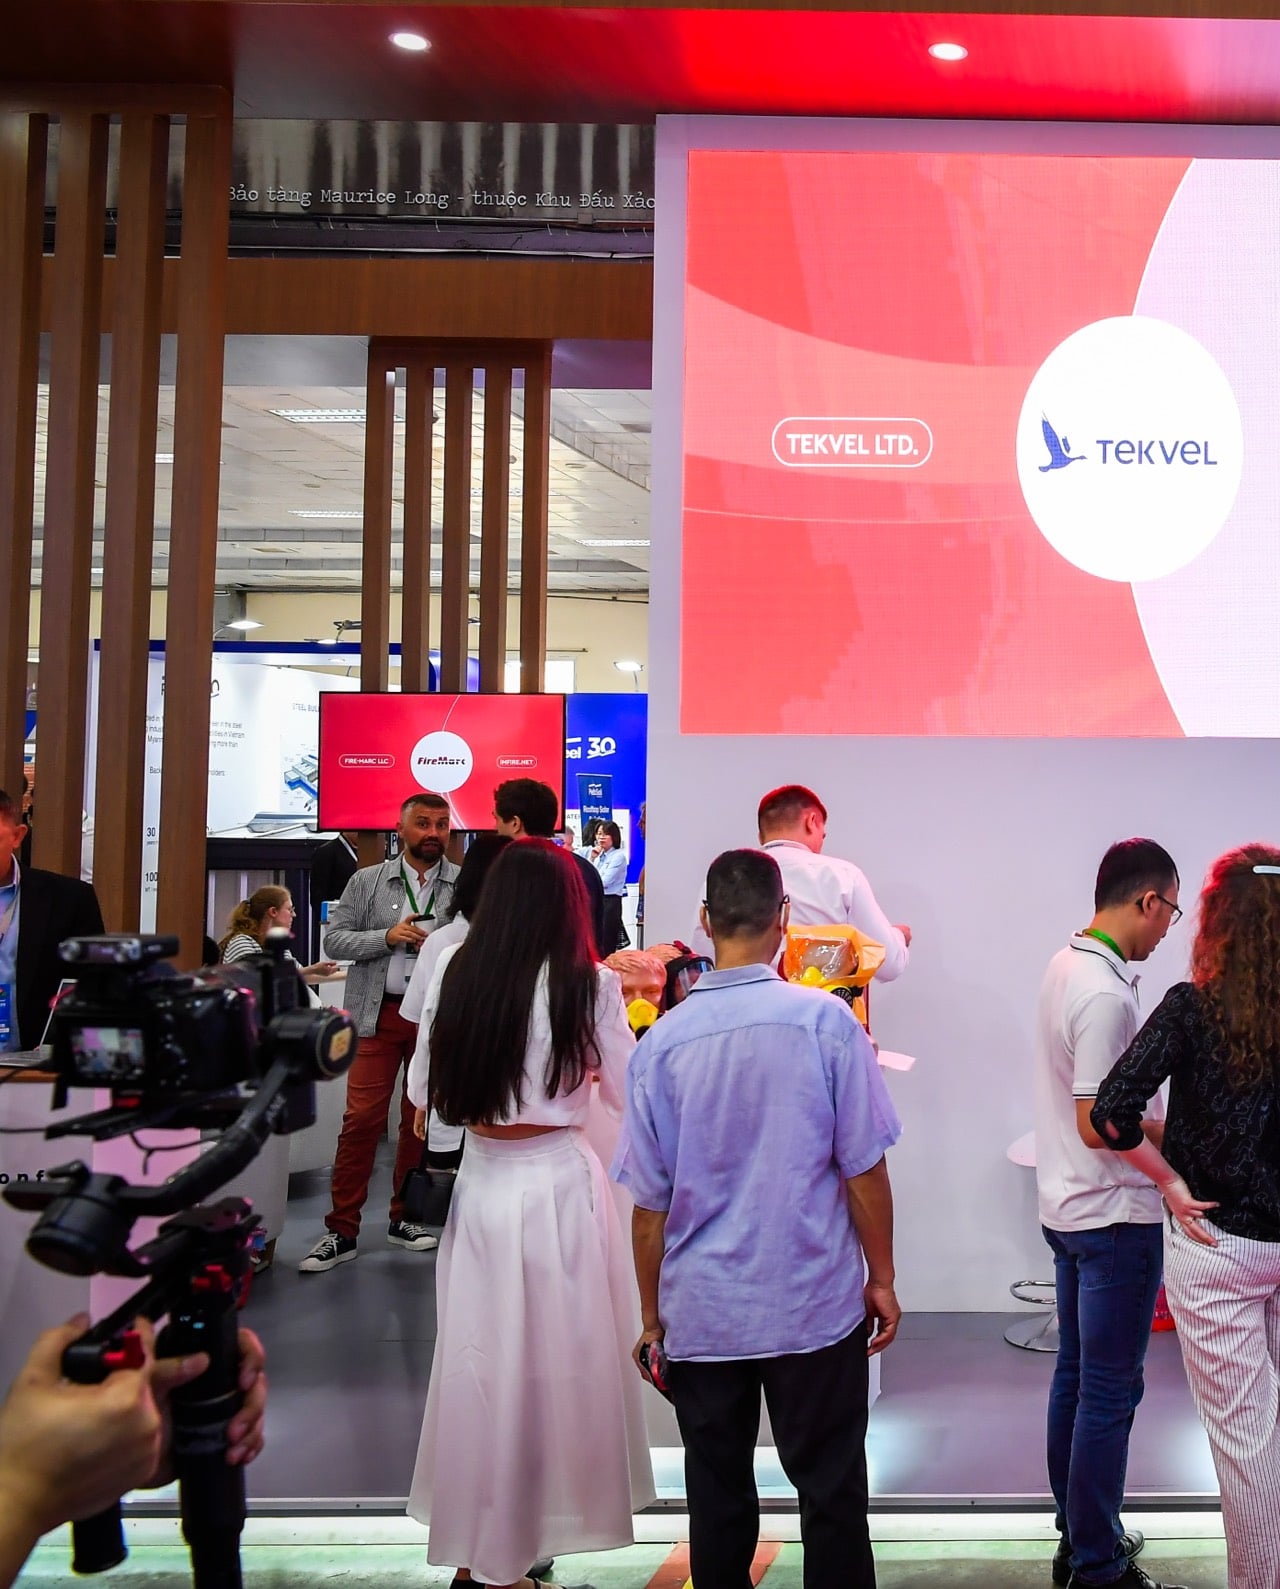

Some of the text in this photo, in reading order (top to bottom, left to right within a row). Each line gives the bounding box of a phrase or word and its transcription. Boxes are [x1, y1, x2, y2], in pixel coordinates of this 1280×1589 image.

[266, 185, 312, 207] tàng
[320, 189, 397, 204] Maurice
[403, 191, 449, 210] Long
[471, 190, 528, 209] thuộc
[535, 192, 572, 207] Khu
[579, 189, 616, 208] Đấu
[622, 191, 656, 209] Xảo
[786, 433, 919, 457] TEKVEL LTD.
[587, 736, 616, 760] 30
[344, 757, 389, 765] FIRE-MARC LLC
[417, 756, 466, 766] FireMarc
[146, 827, 156, 837] 30
